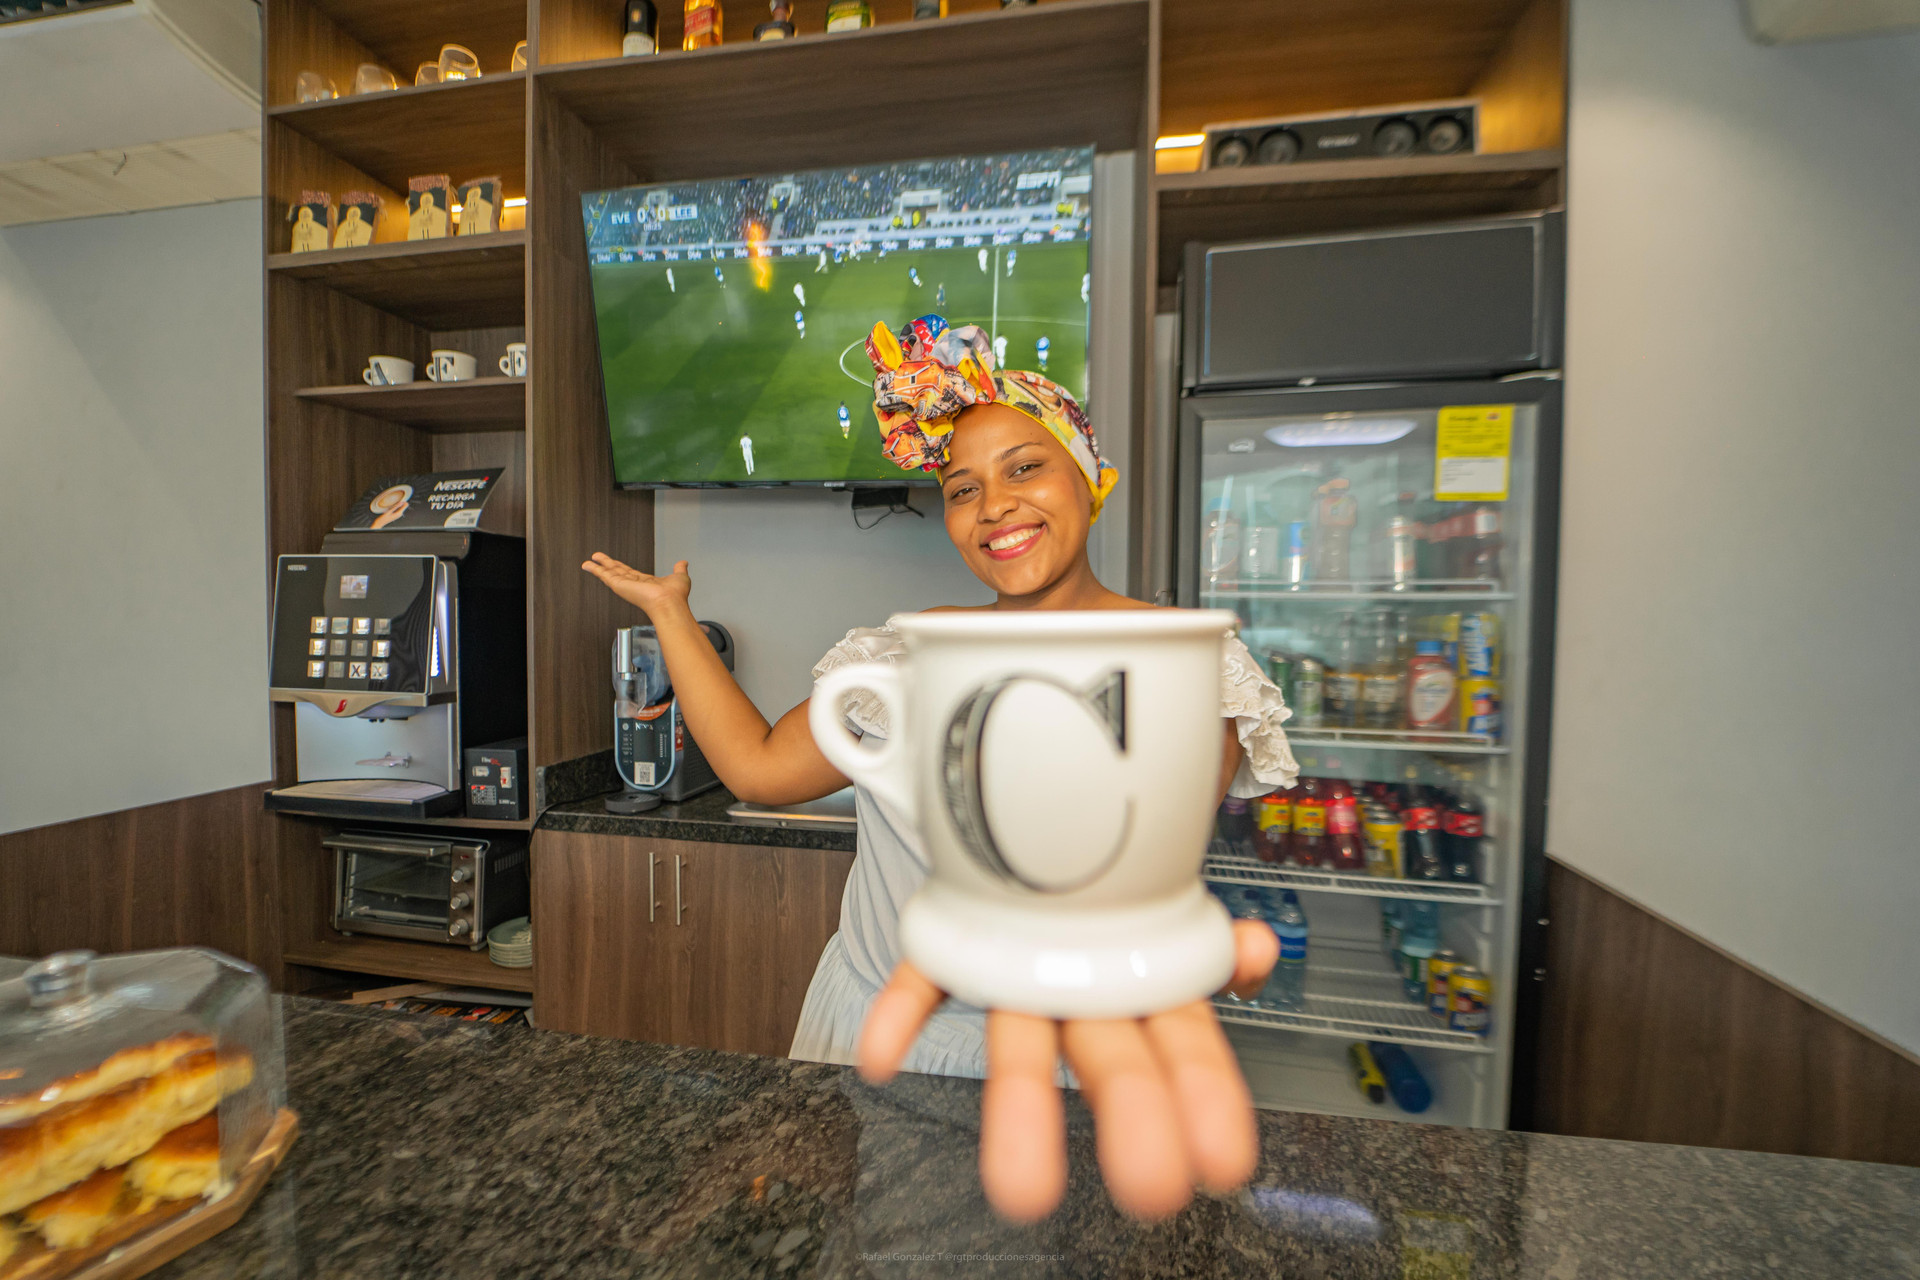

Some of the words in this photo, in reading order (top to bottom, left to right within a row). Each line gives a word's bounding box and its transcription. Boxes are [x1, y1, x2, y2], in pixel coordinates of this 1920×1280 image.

[1016, 170, 1061, 190] ESPN
[611, 211, 630, 224] EVE
[637, 207, 646, 223] 0
[658, 205, 666, 221] 0
[675, 207, 692, 219] LEE
[427, 493, 475, 502] RECARGA
[430, 502, 445, 510] TU
[941, 669, 1136, 893] C
